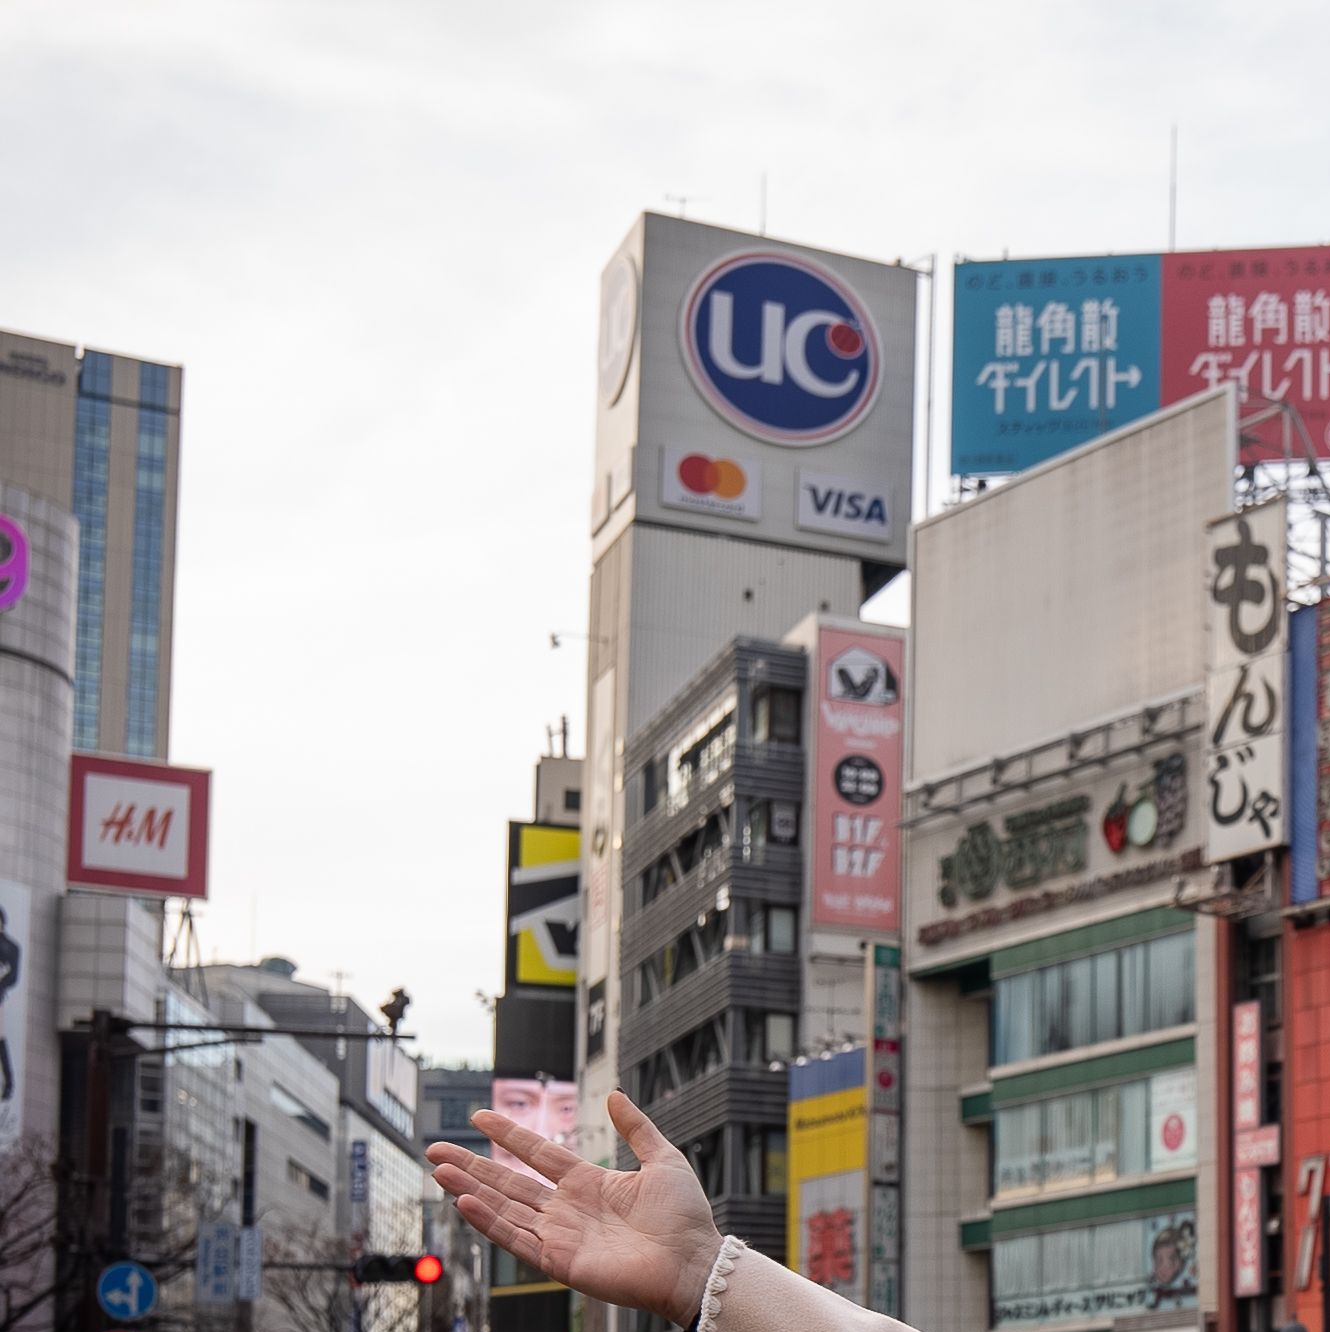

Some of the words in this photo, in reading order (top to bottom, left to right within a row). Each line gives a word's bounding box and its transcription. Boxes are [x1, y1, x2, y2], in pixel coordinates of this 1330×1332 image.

[994, 297, 1121, 358] 龍角散
[805, 484, 888, 527] VISA
[1208, 519, 1280, 840] もんじゃ
[99, 799, 175, 850] H&M
